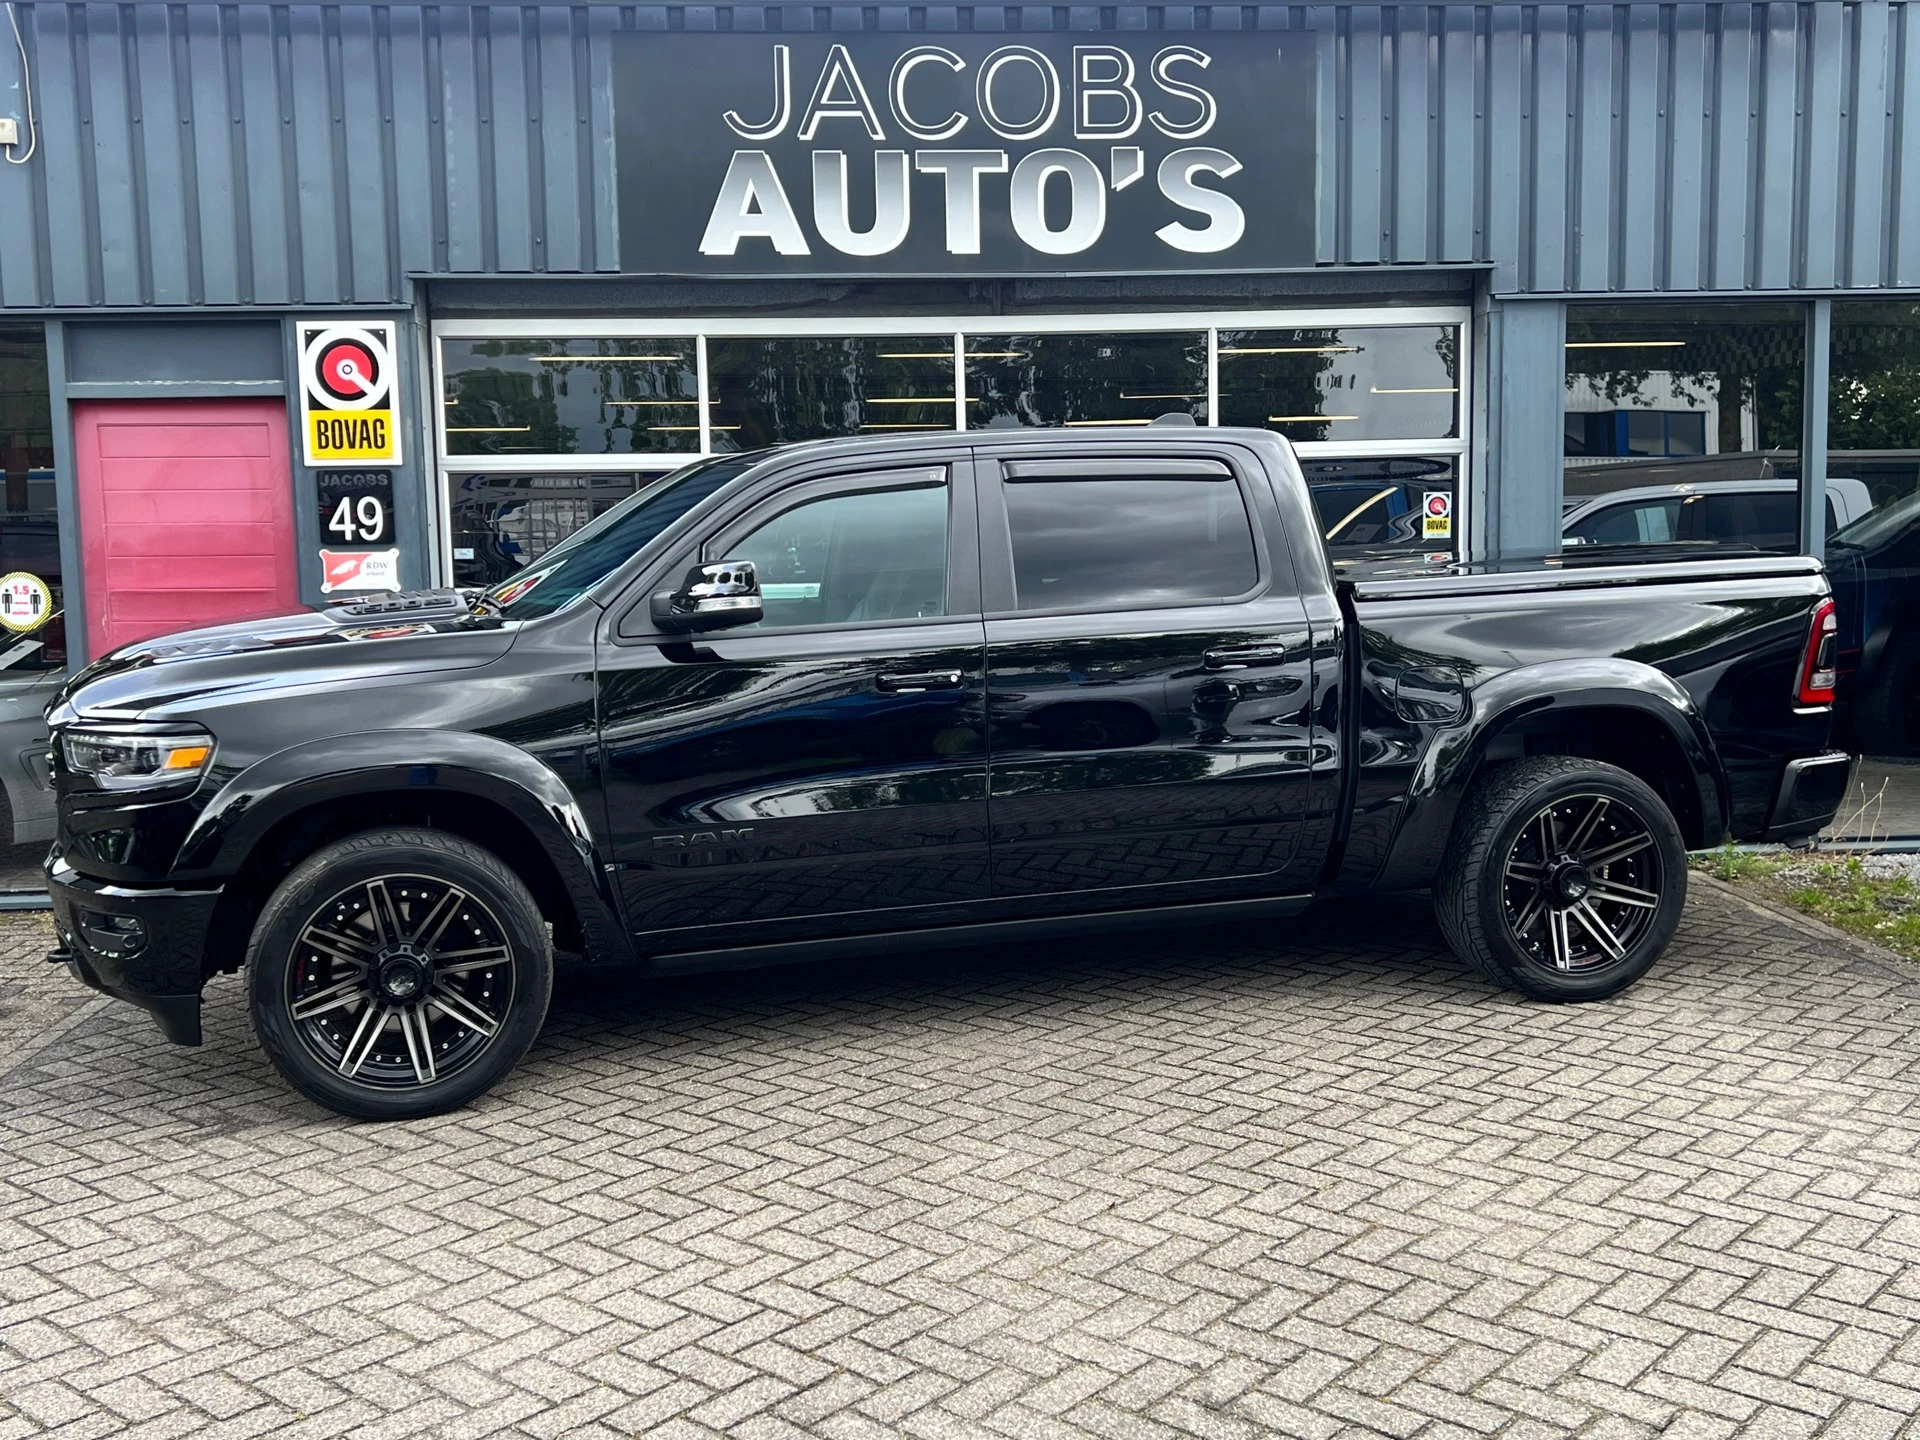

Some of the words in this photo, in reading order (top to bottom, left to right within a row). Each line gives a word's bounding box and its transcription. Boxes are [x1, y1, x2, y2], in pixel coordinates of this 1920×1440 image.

[722, 44, 1217, 141] JACOBS
[698, 146, 1246, 256] AUTO'S
[316, 418, 386, 450] BOVAG
[319, 473, 389, 487] JACOBS
[328, 495, 384, 541] 49
[1427, 520, 1447, 530] BOVAG
[366, 562, 389, 570] RDW
[13, 585, 29, 595] 1.5
[652, 828, 754, 848] RAM
